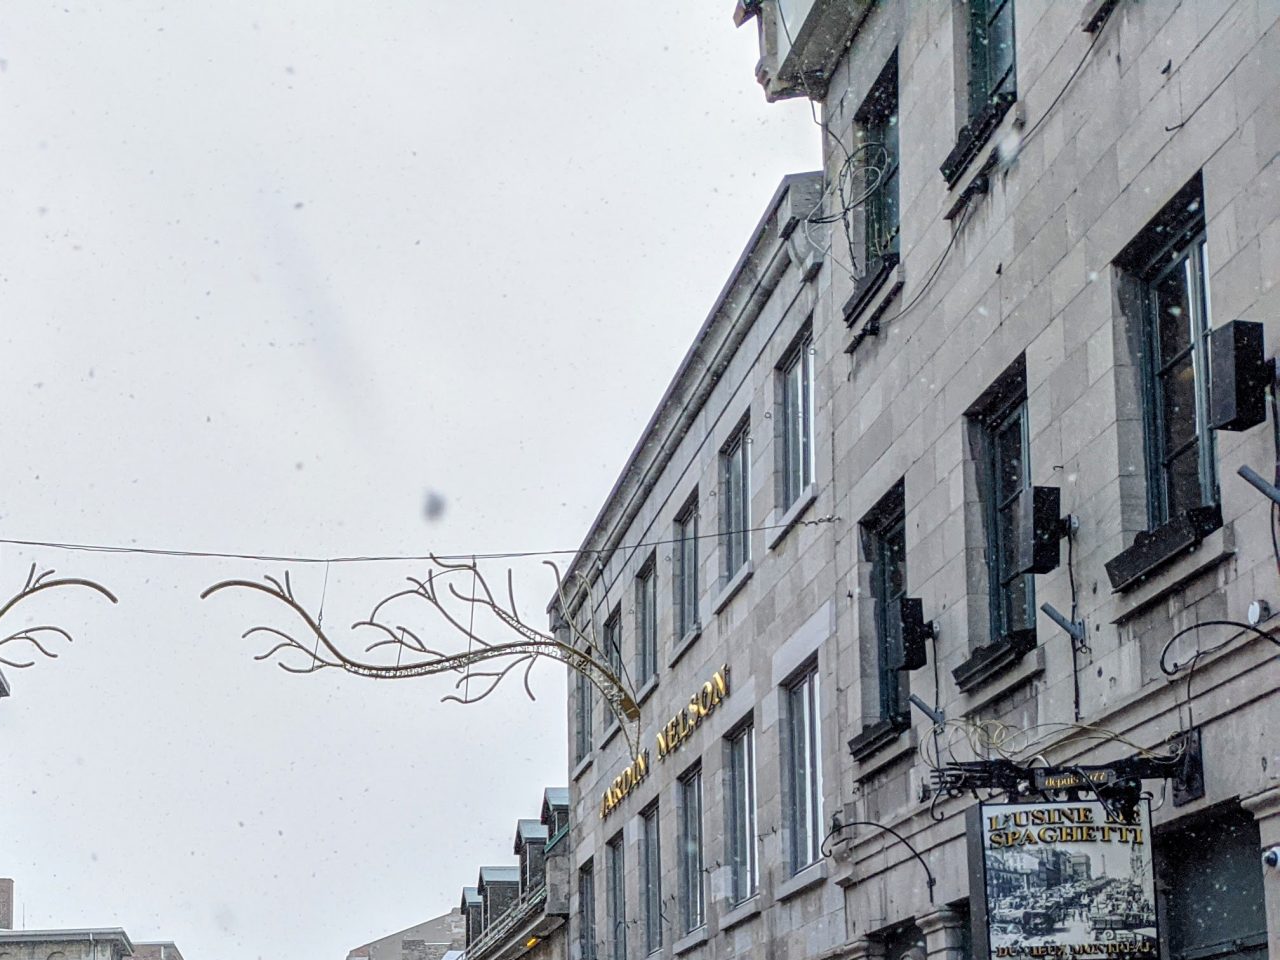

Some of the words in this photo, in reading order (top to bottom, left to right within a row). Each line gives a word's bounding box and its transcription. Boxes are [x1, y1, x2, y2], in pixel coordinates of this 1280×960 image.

[656, 663, 731, 763] NELSON
[1045, 774, 1079, 788] depuis
[987, 807, 1093, 832] L'USINE
[989, 824, 1144, 849] SPAGHETTI
